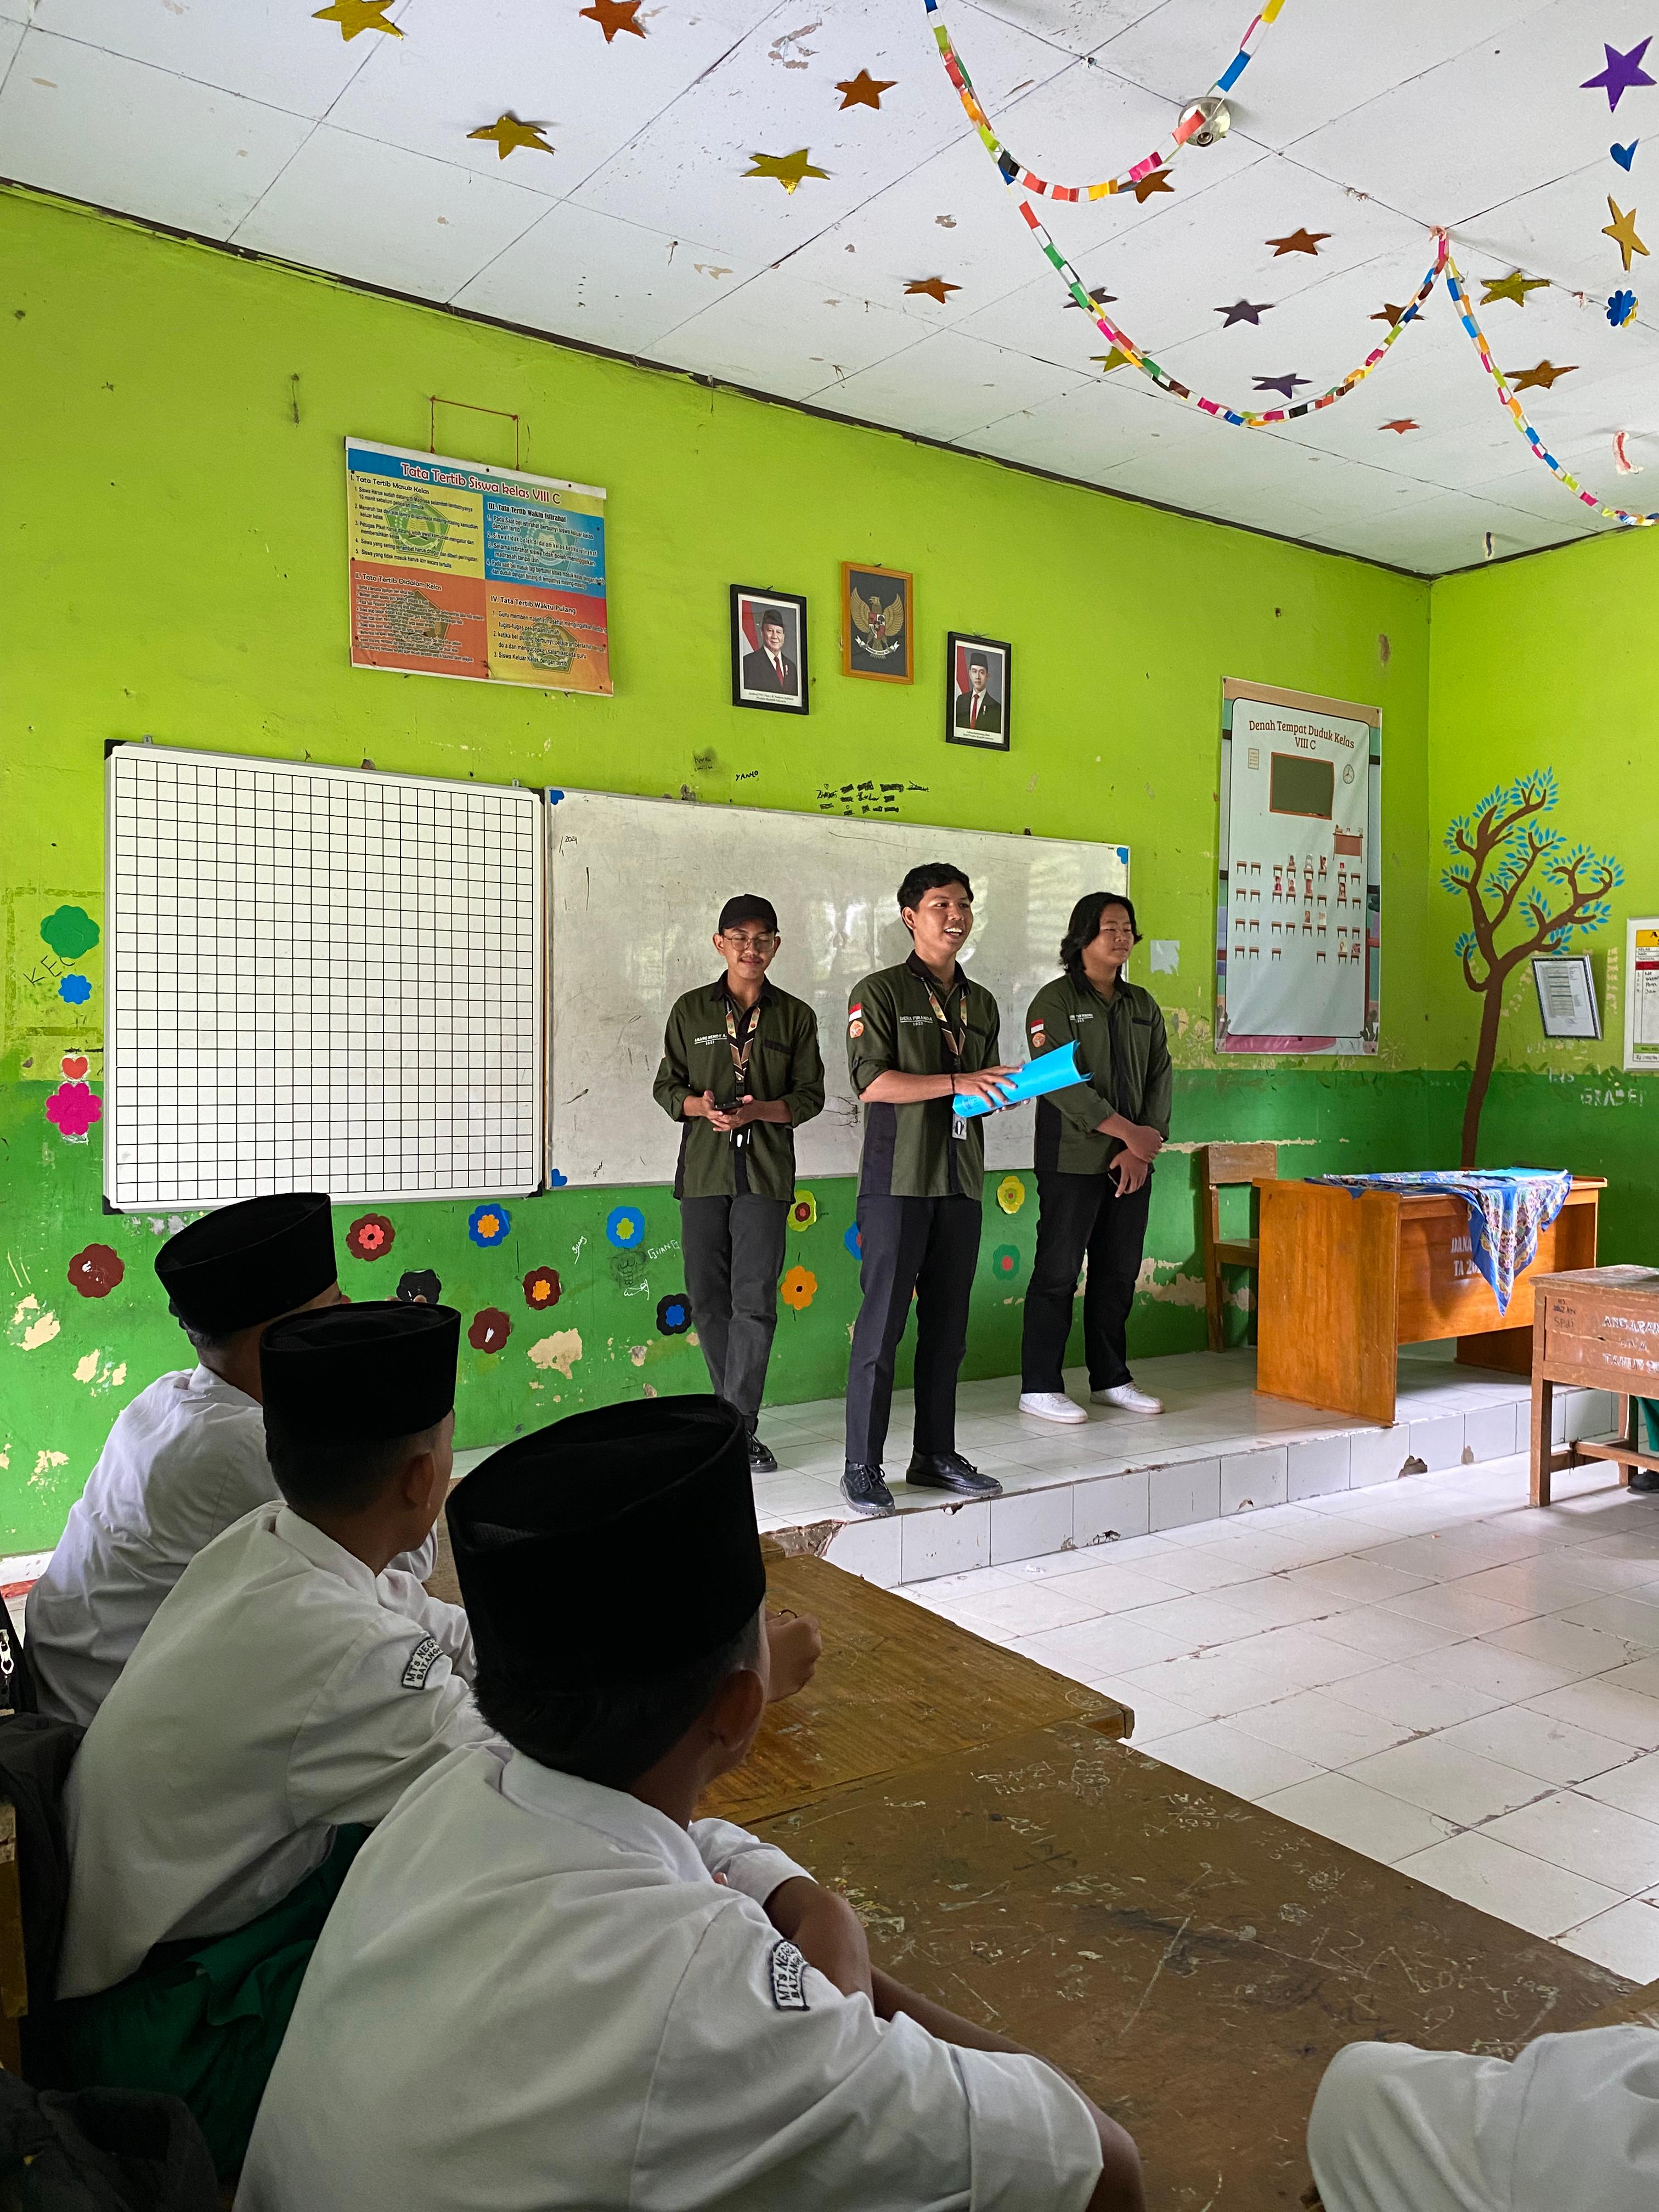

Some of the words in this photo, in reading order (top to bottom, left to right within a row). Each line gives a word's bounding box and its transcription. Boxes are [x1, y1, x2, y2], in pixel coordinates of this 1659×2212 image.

[356, 475, 370, 483] Tata
[373, 478, 391, 487] Tertib
[392, 482, 412, 491] Masuk
[414, 486, 429, 494] Kelas
[402, 463, 428, 479] Tata
[432, 469, 465, 486] Tertib
[469, 476, 498, 492] Siswa
[502, 483, 529, 498] kelas
[532, 489, 549, 502] VIII
[552, 493, 560, 504] C
[511, 506, 526, 515] Tertib
[527, 510, 543, 518] Waktu
[545, 513, 566, 522] Istirahat
[492, 522, 508, 532] dengan
[399, 578, 424, 587] Didalam
[555, 605, 575, 614] Pulang
[499, 622, 523, 631] tugas-tugas
[1249, 720, 1276, 731] Denah
[1277, 721, 1306, 735] Tempat
[1308, 725, 1333, 741] Duduk
[1334, 732, 1355, 748] Kelas
[1295, 737, 1308, 748] VIII
[1310, 740, 1316, 749] C
[565, 836, 577, 845] 2024
